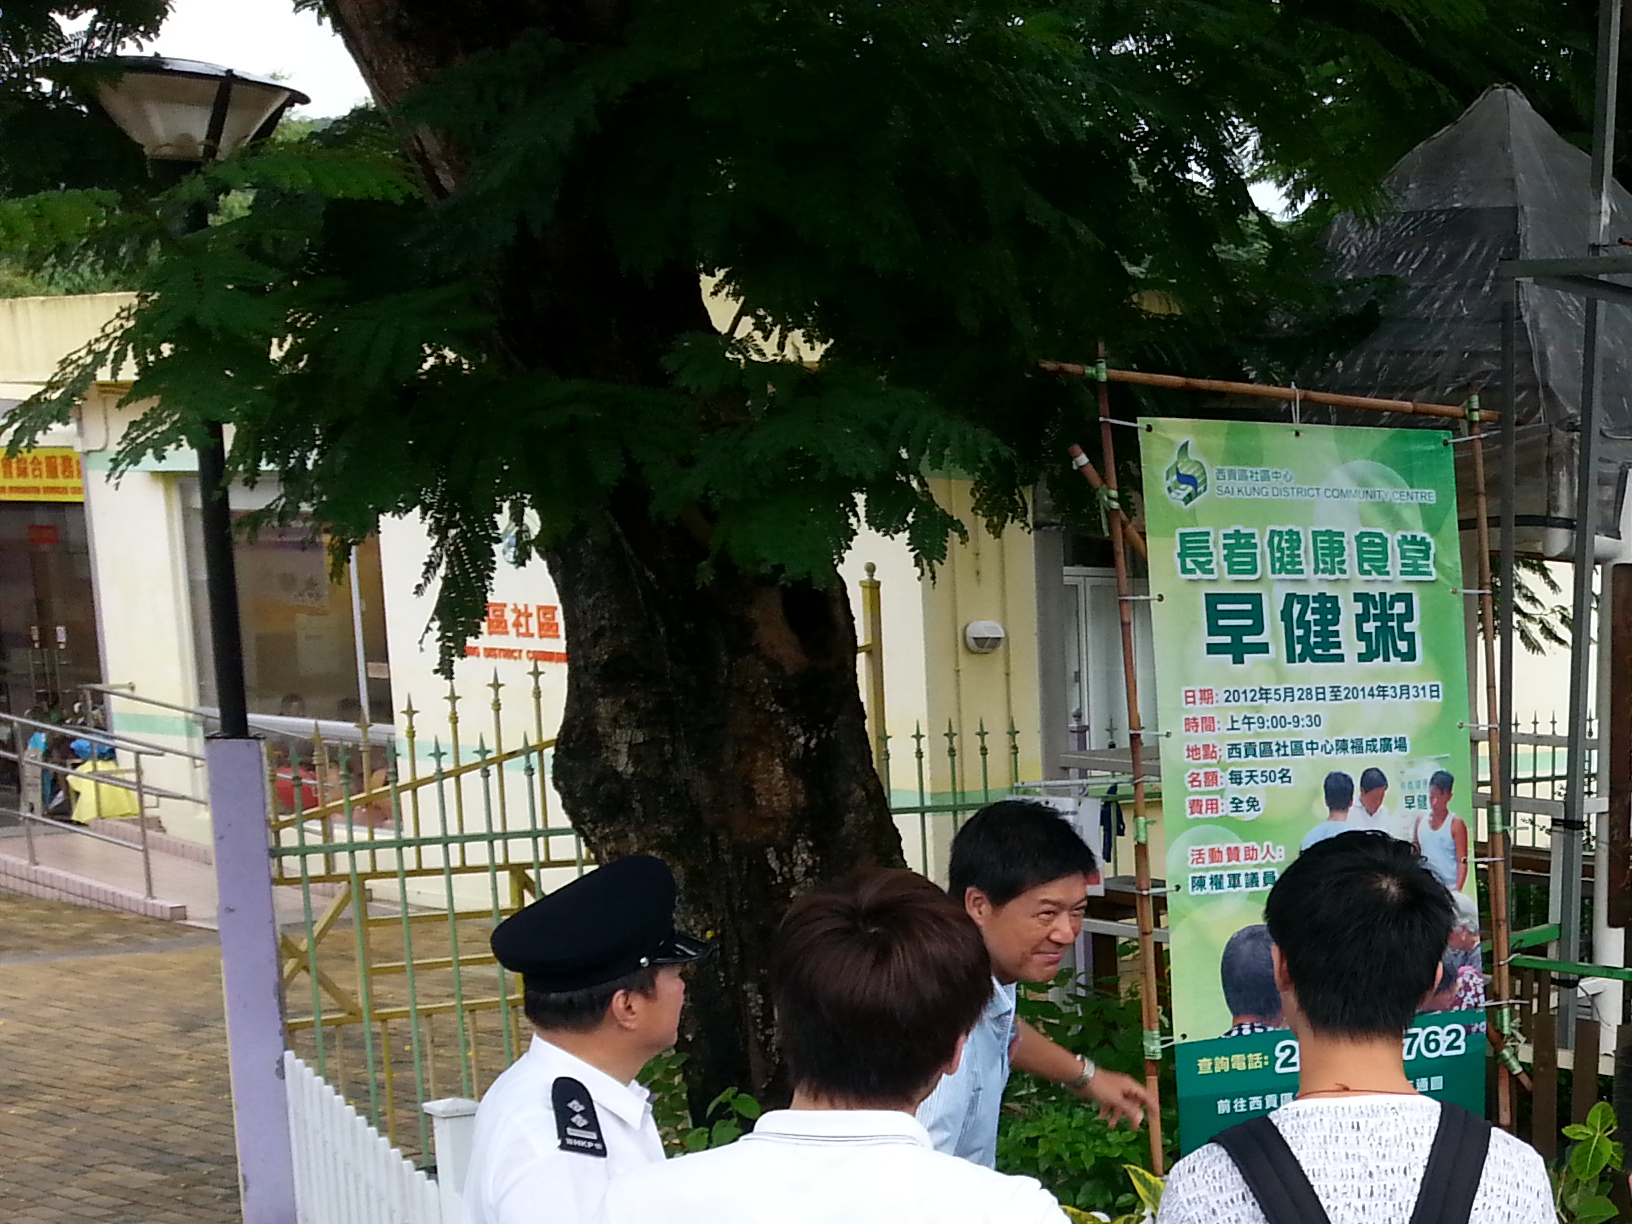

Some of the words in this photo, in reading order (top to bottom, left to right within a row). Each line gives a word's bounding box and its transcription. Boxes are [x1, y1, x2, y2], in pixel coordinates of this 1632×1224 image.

[1216, 485, 1235, 497] SAI
[1237, 486, 1269, 498] KUNG
[1271, 487, 1320, 499] DISTRICT
[1323, 488, 1389, 501] COMMUNITY
[1391, 491, 1435, 501] CENTRE
[1176, 528, 1434, 578] 長者健康食堂
[1203, 591, 1418, 665] 早健粥
[1184, 688, 1219, 706] 日期:
[1223, 684, 1440, 704] 2012年5月28日至2014年3月31日
[1184, 716, 1221, 733] 時間:
[1226, 714, 1322, 732] 上午9:00-9:30
[1187, 771, 1224, 788] 名額:
[1228, 767, 1292, 787] 每天50名
[1188, 798, 1225, 816] 費用:
[1229, 796, 1261, 814] 全免
